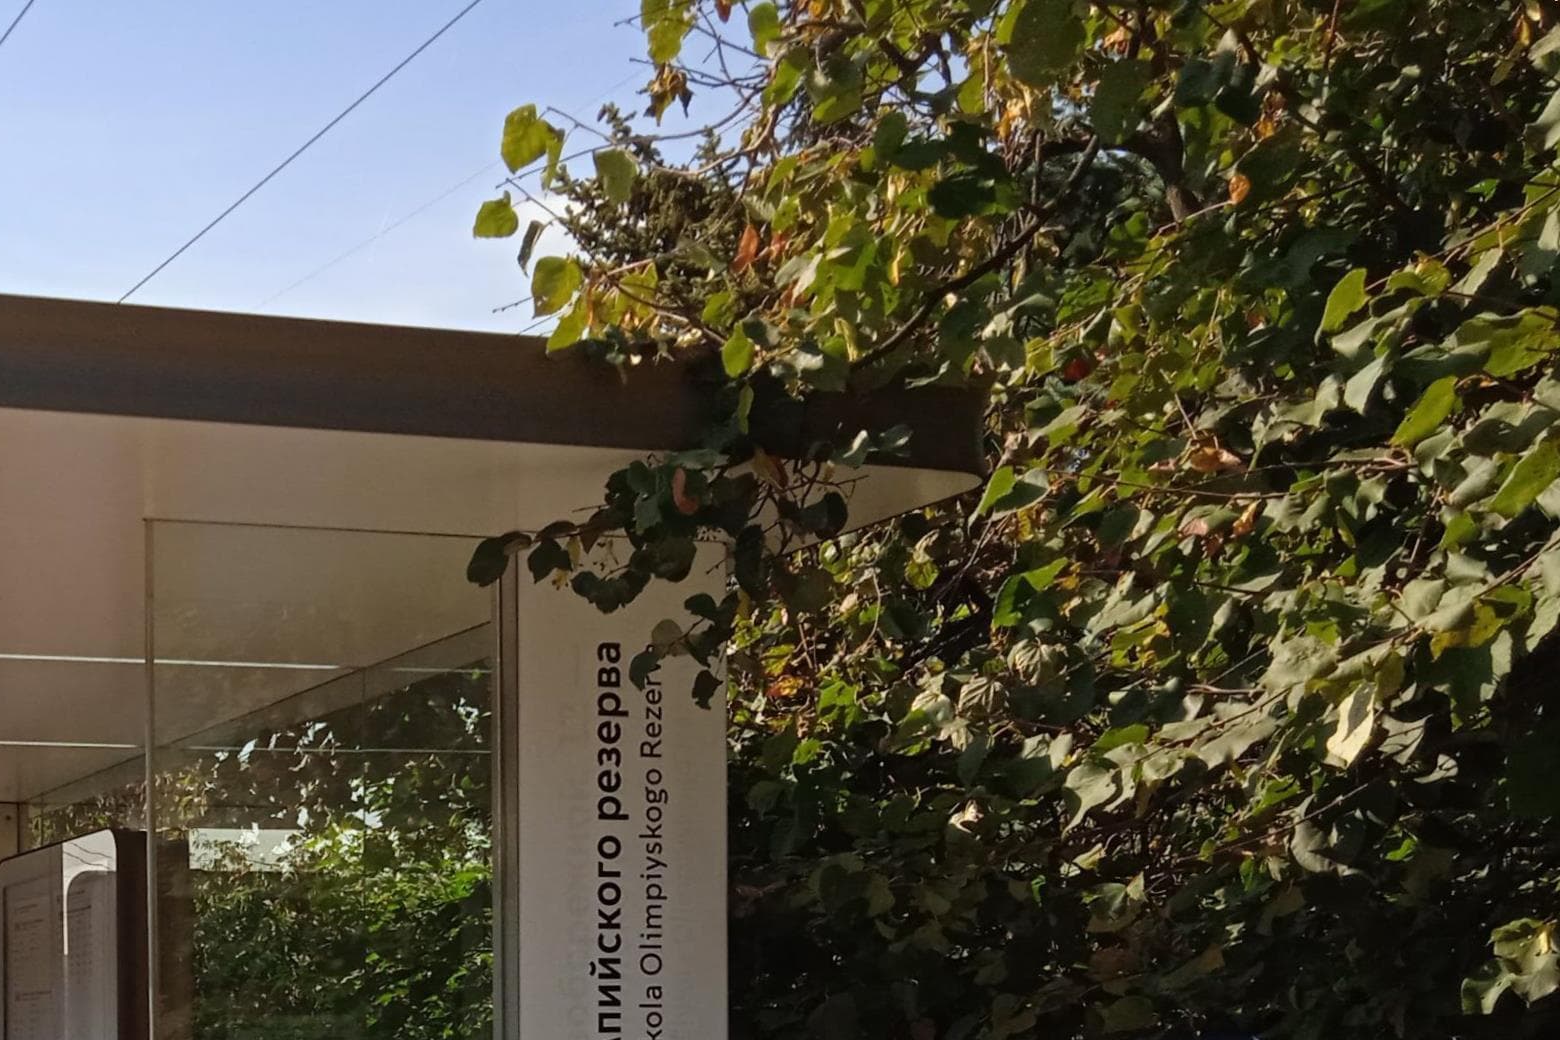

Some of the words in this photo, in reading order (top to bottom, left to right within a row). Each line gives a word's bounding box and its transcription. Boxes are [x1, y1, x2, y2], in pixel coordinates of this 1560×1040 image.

[597, 642, 629, 820] резерва
[640, 645, 662, 757] Rezer
[639, 769, 668, 975] Olimpiyskogo
